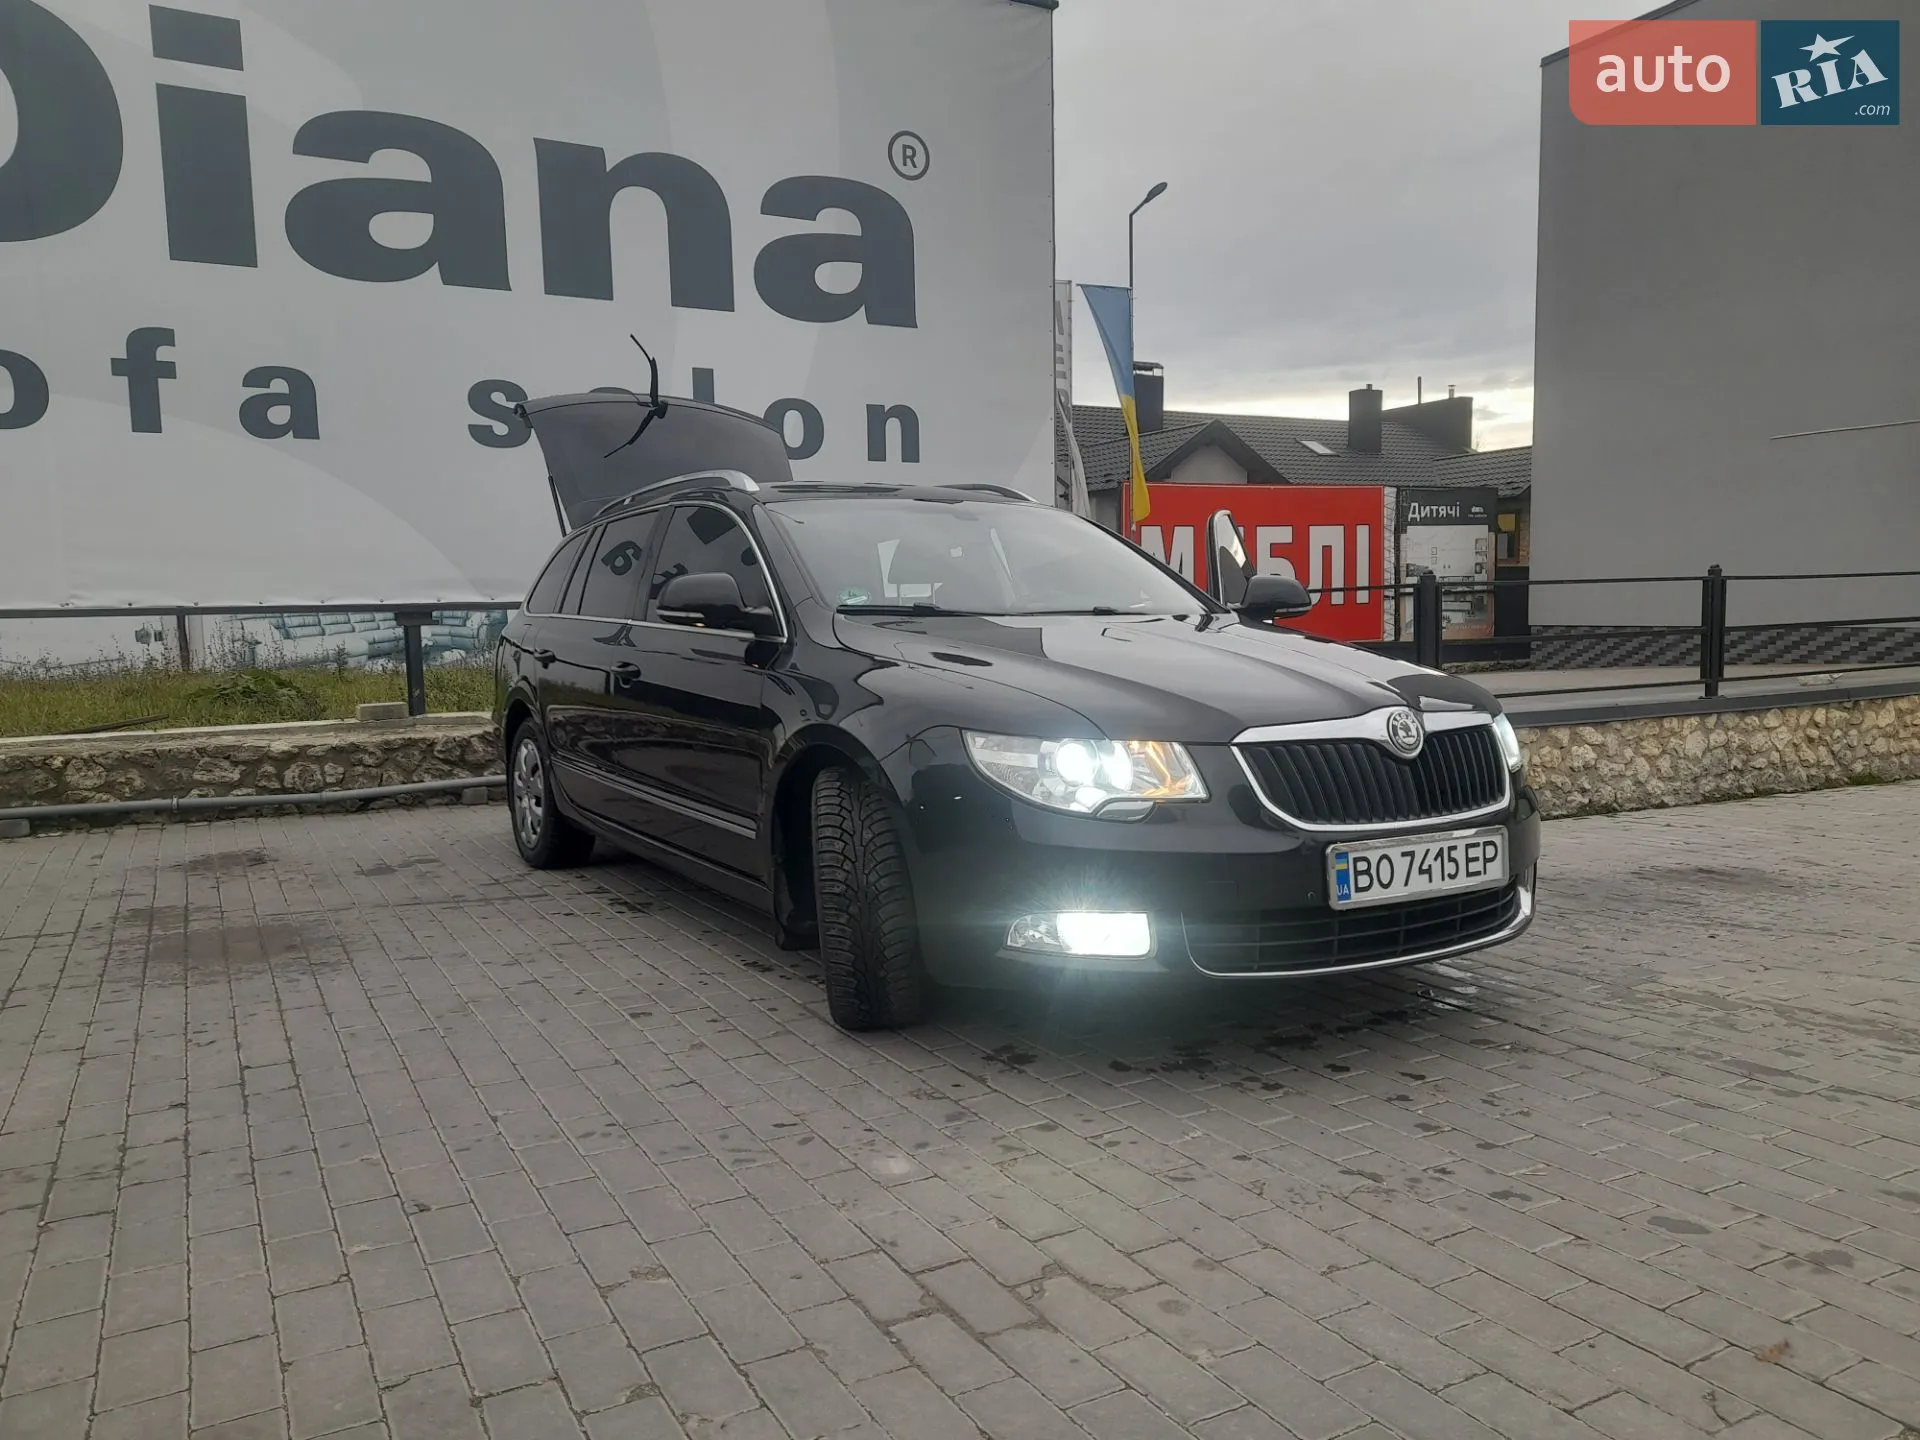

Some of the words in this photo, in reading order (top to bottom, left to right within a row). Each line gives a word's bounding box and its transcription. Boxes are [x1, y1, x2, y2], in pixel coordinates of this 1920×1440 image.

[1408, 501, 1460, 522] Дитячі
[1140, 524, 1371, 606] МБЛІ
[1336, 884, 1349, 895] UA
[1401, 845, 1460, 887] 7415
